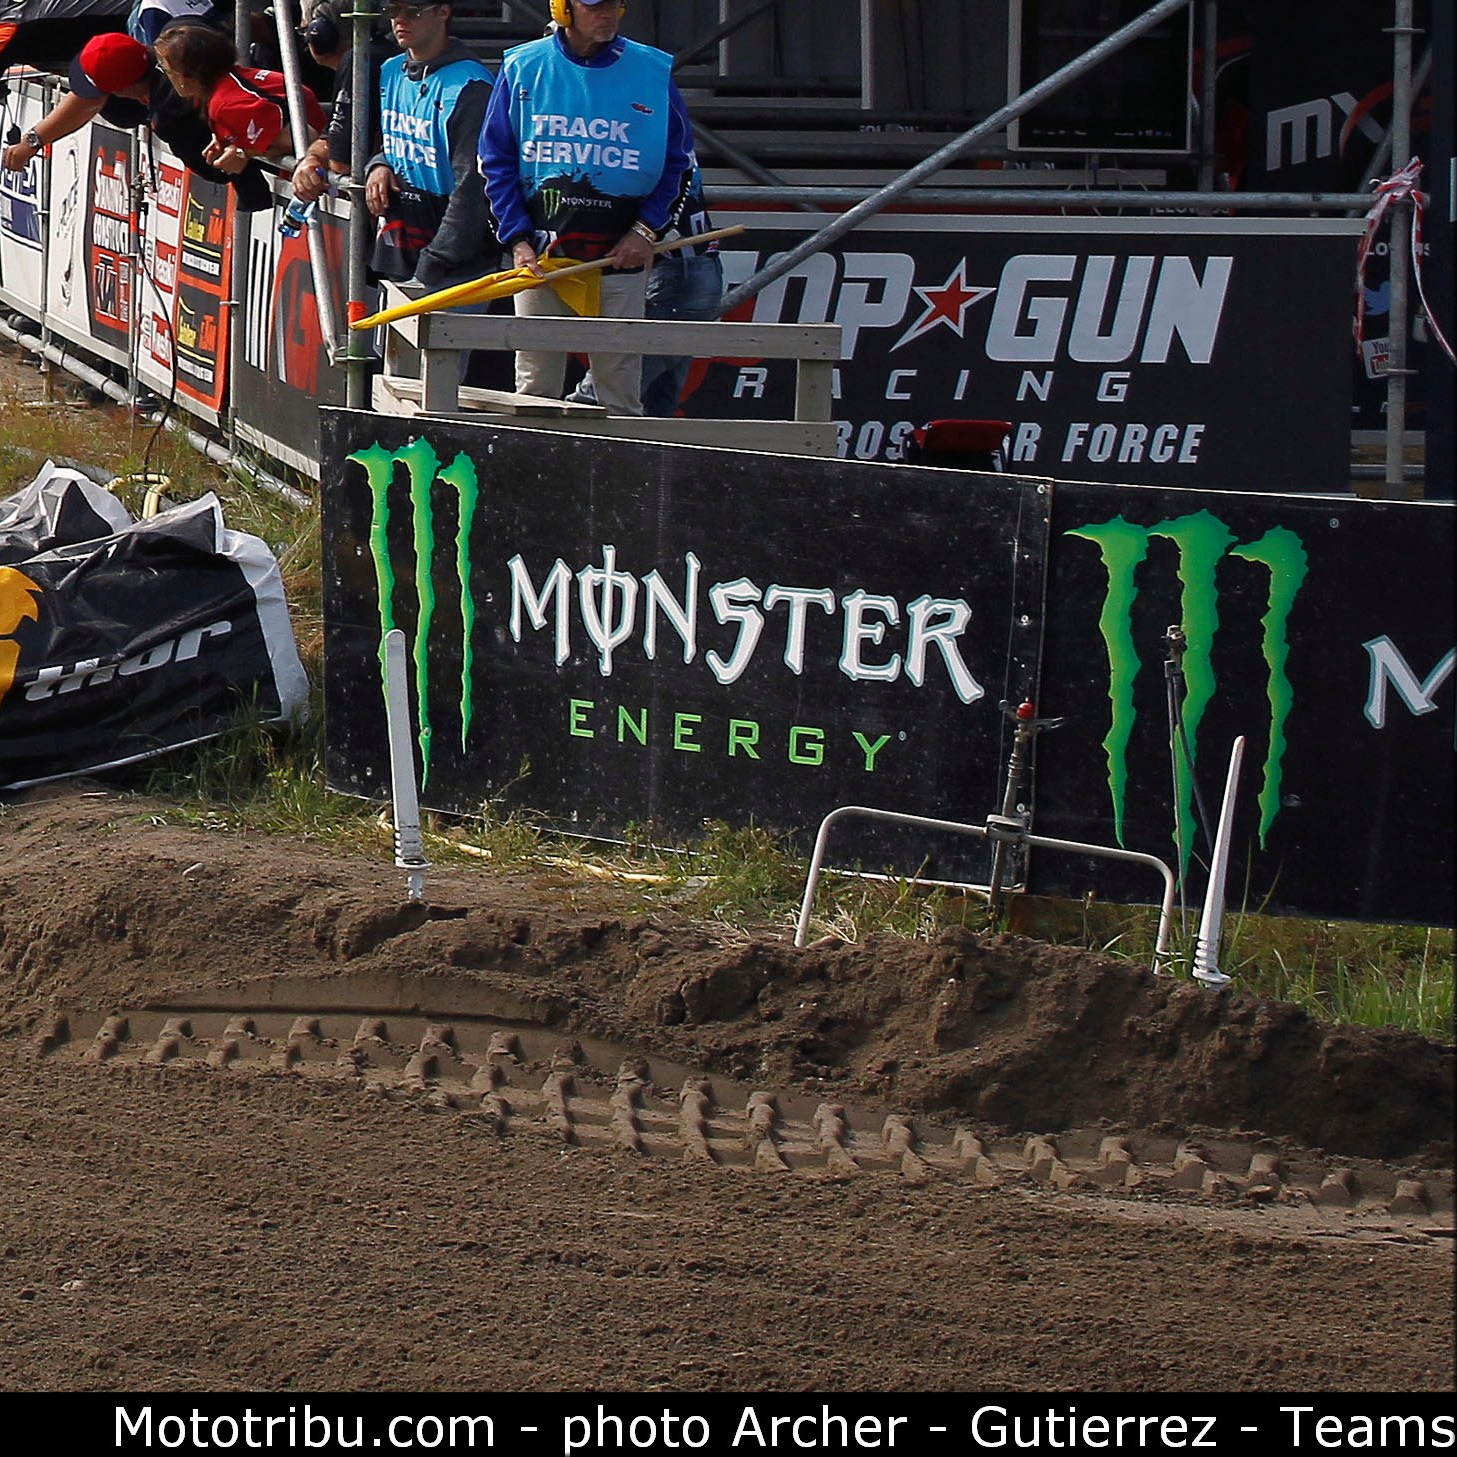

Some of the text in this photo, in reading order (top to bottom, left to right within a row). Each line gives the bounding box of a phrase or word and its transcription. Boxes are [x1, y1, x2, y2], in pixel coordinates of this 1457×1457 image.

[521, 140, 641, 171] SERVICE
[530, 114, 631, 144] TRACK
[560, 196, 613, 209] MONSTER
[985, 253, 1234, 365] GUN
[1062, 422, 1206, 465] FORCE
[507, 545, 985, 704] MONSTER
[25, 620, 232, 702] thor
[569, 698, 892, 772] ENERGY
